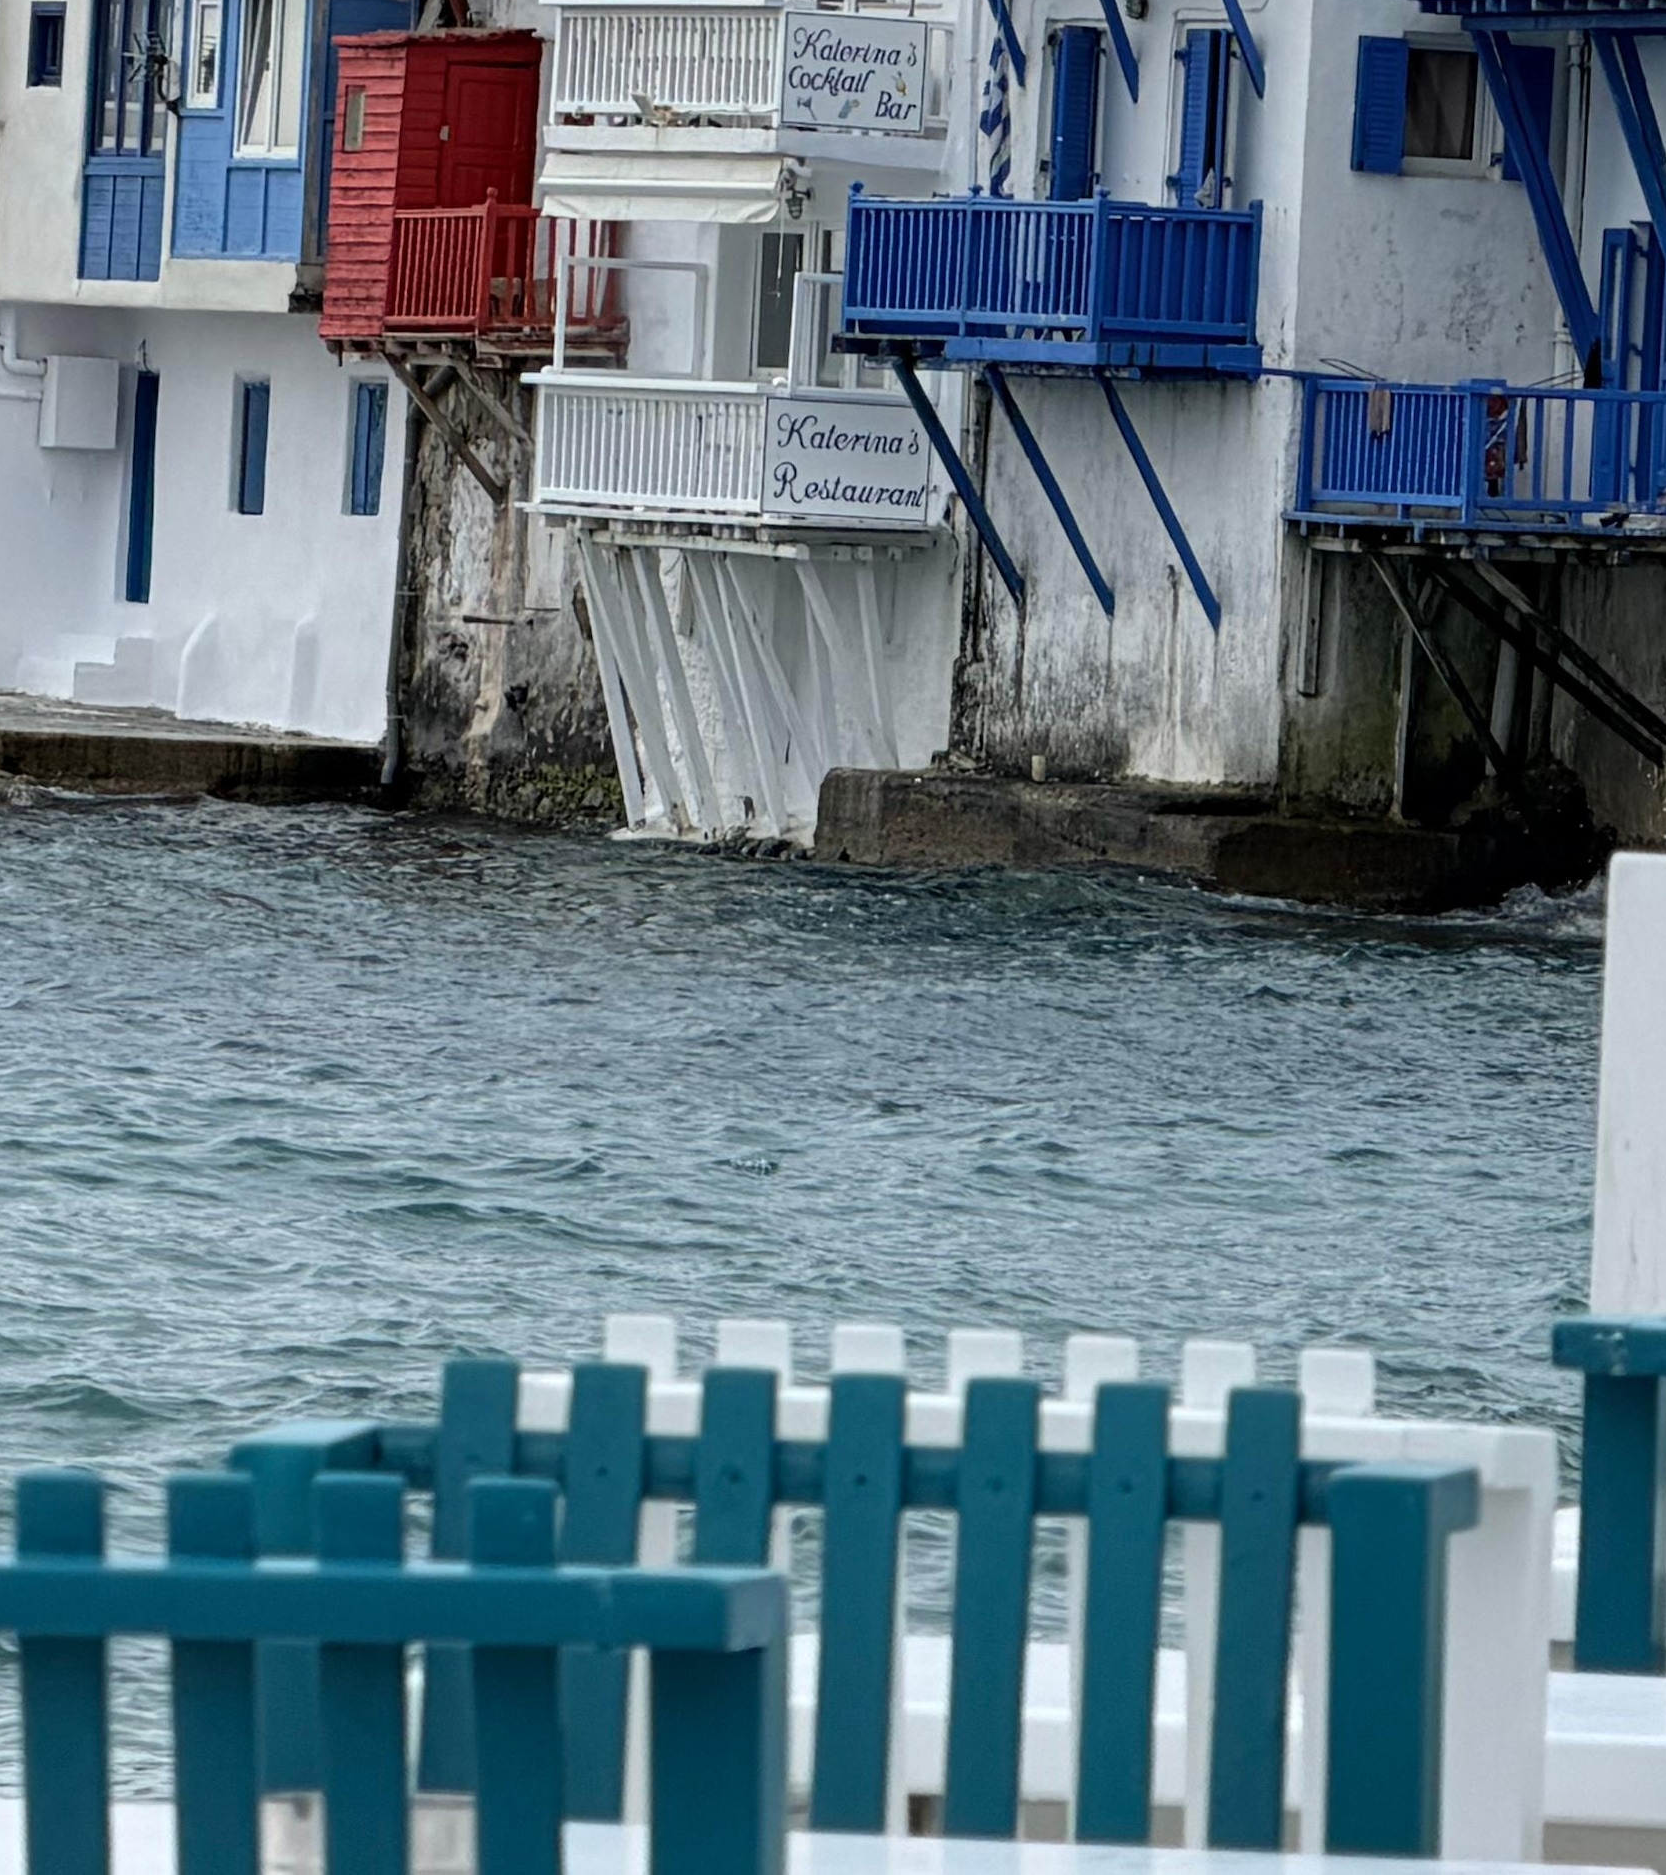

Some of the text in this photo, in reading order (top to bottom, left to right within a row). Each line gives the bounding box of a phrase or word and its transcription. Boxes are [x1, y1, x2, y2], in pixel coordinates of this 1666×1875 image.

[789, 65, 876, 96] Cocktail
[875, 90, 917, 120] Bar
[777, 413, 919, 455] Katerina's
[773, 461, 925, 507] Restaurant
